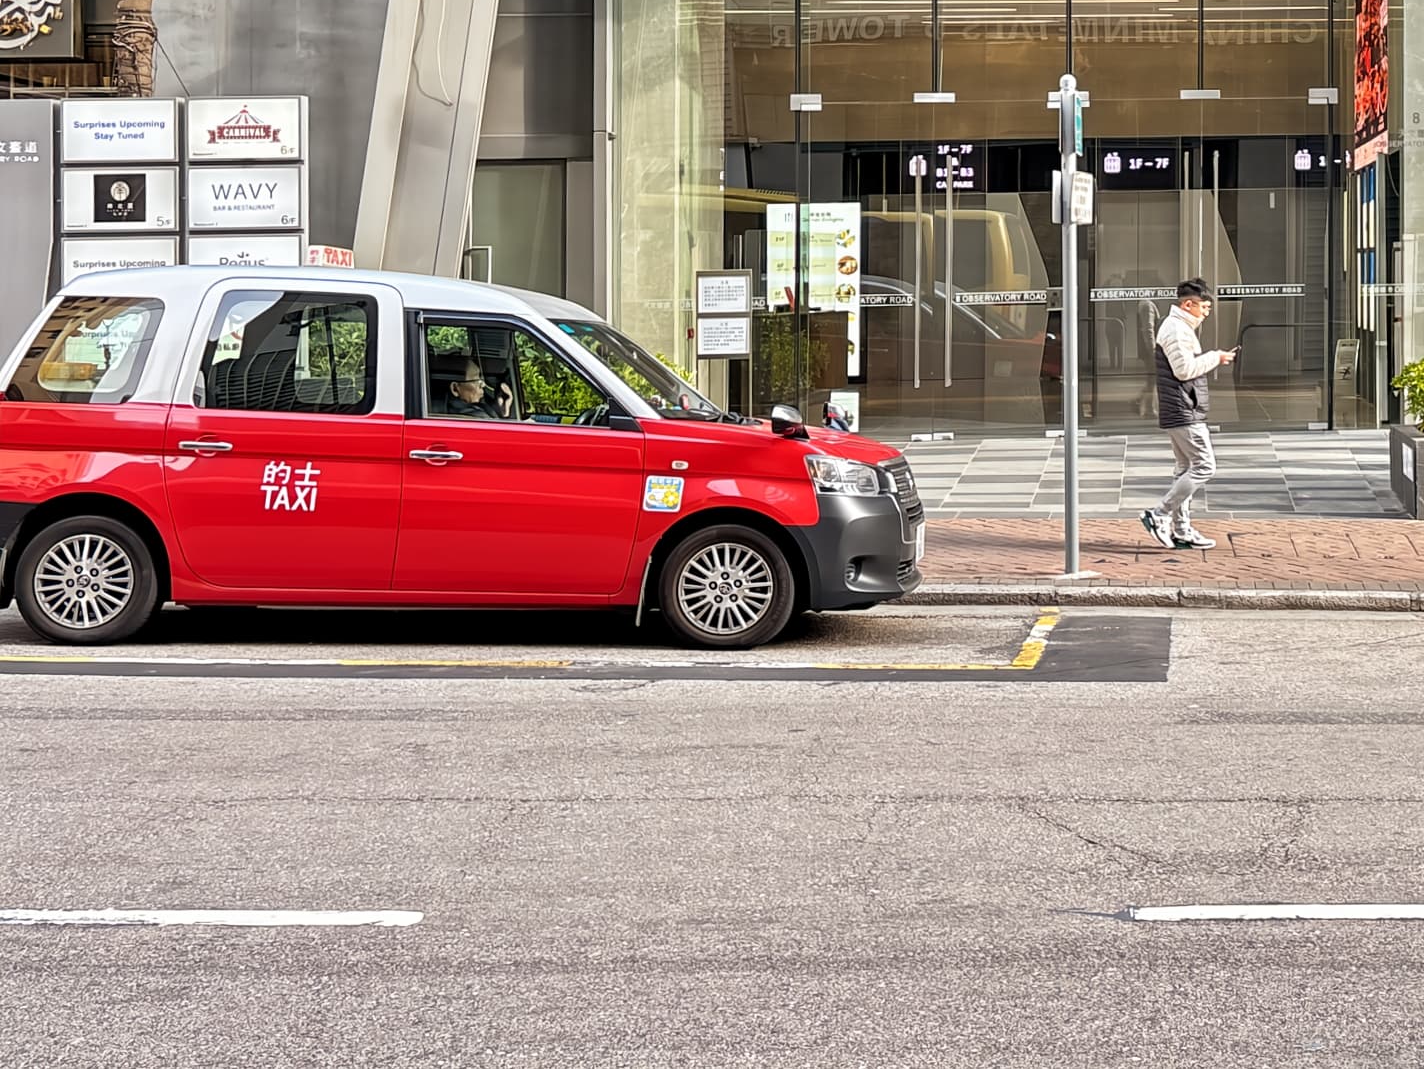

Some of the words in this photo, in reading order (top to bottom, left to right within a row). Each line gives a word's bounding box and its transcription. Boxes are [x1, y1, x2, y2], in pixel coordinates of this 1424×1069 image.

[1412, 111, 1421, 125] 8
[73, 120, 117, 130] Surprises
[119, 119, 166, 130] Upcoming
[94, 132, 115, 142] Stay
[117, 131, 145, 140] Tuned
[223, 127, 267, 138] CARNIVAL
[211, 182, 278, 201] WAVY
[212, 204, 226, 212] BAR
[233, 204, 275, 212] RESTAURANT
[281, 214, 297, 225] 6/F
[324, 247, 353, 267] TAXI
[73, 259, 117, 270] Surprises
[119, 259, 166, 269] Upcoming
[1096, 289, 1156, 299] OBSERVATORY
[1225, 286, 1280, 295] OBSERVATORY
[1282, 285, 1303, 294] ROAD
[961, 293, 1022, 304] OBSERVATORY
[1023, 292, 1047, 302] ROAD
[262, 460, 321, 487] 的士
[259, 484, 319, 512] TAXI
